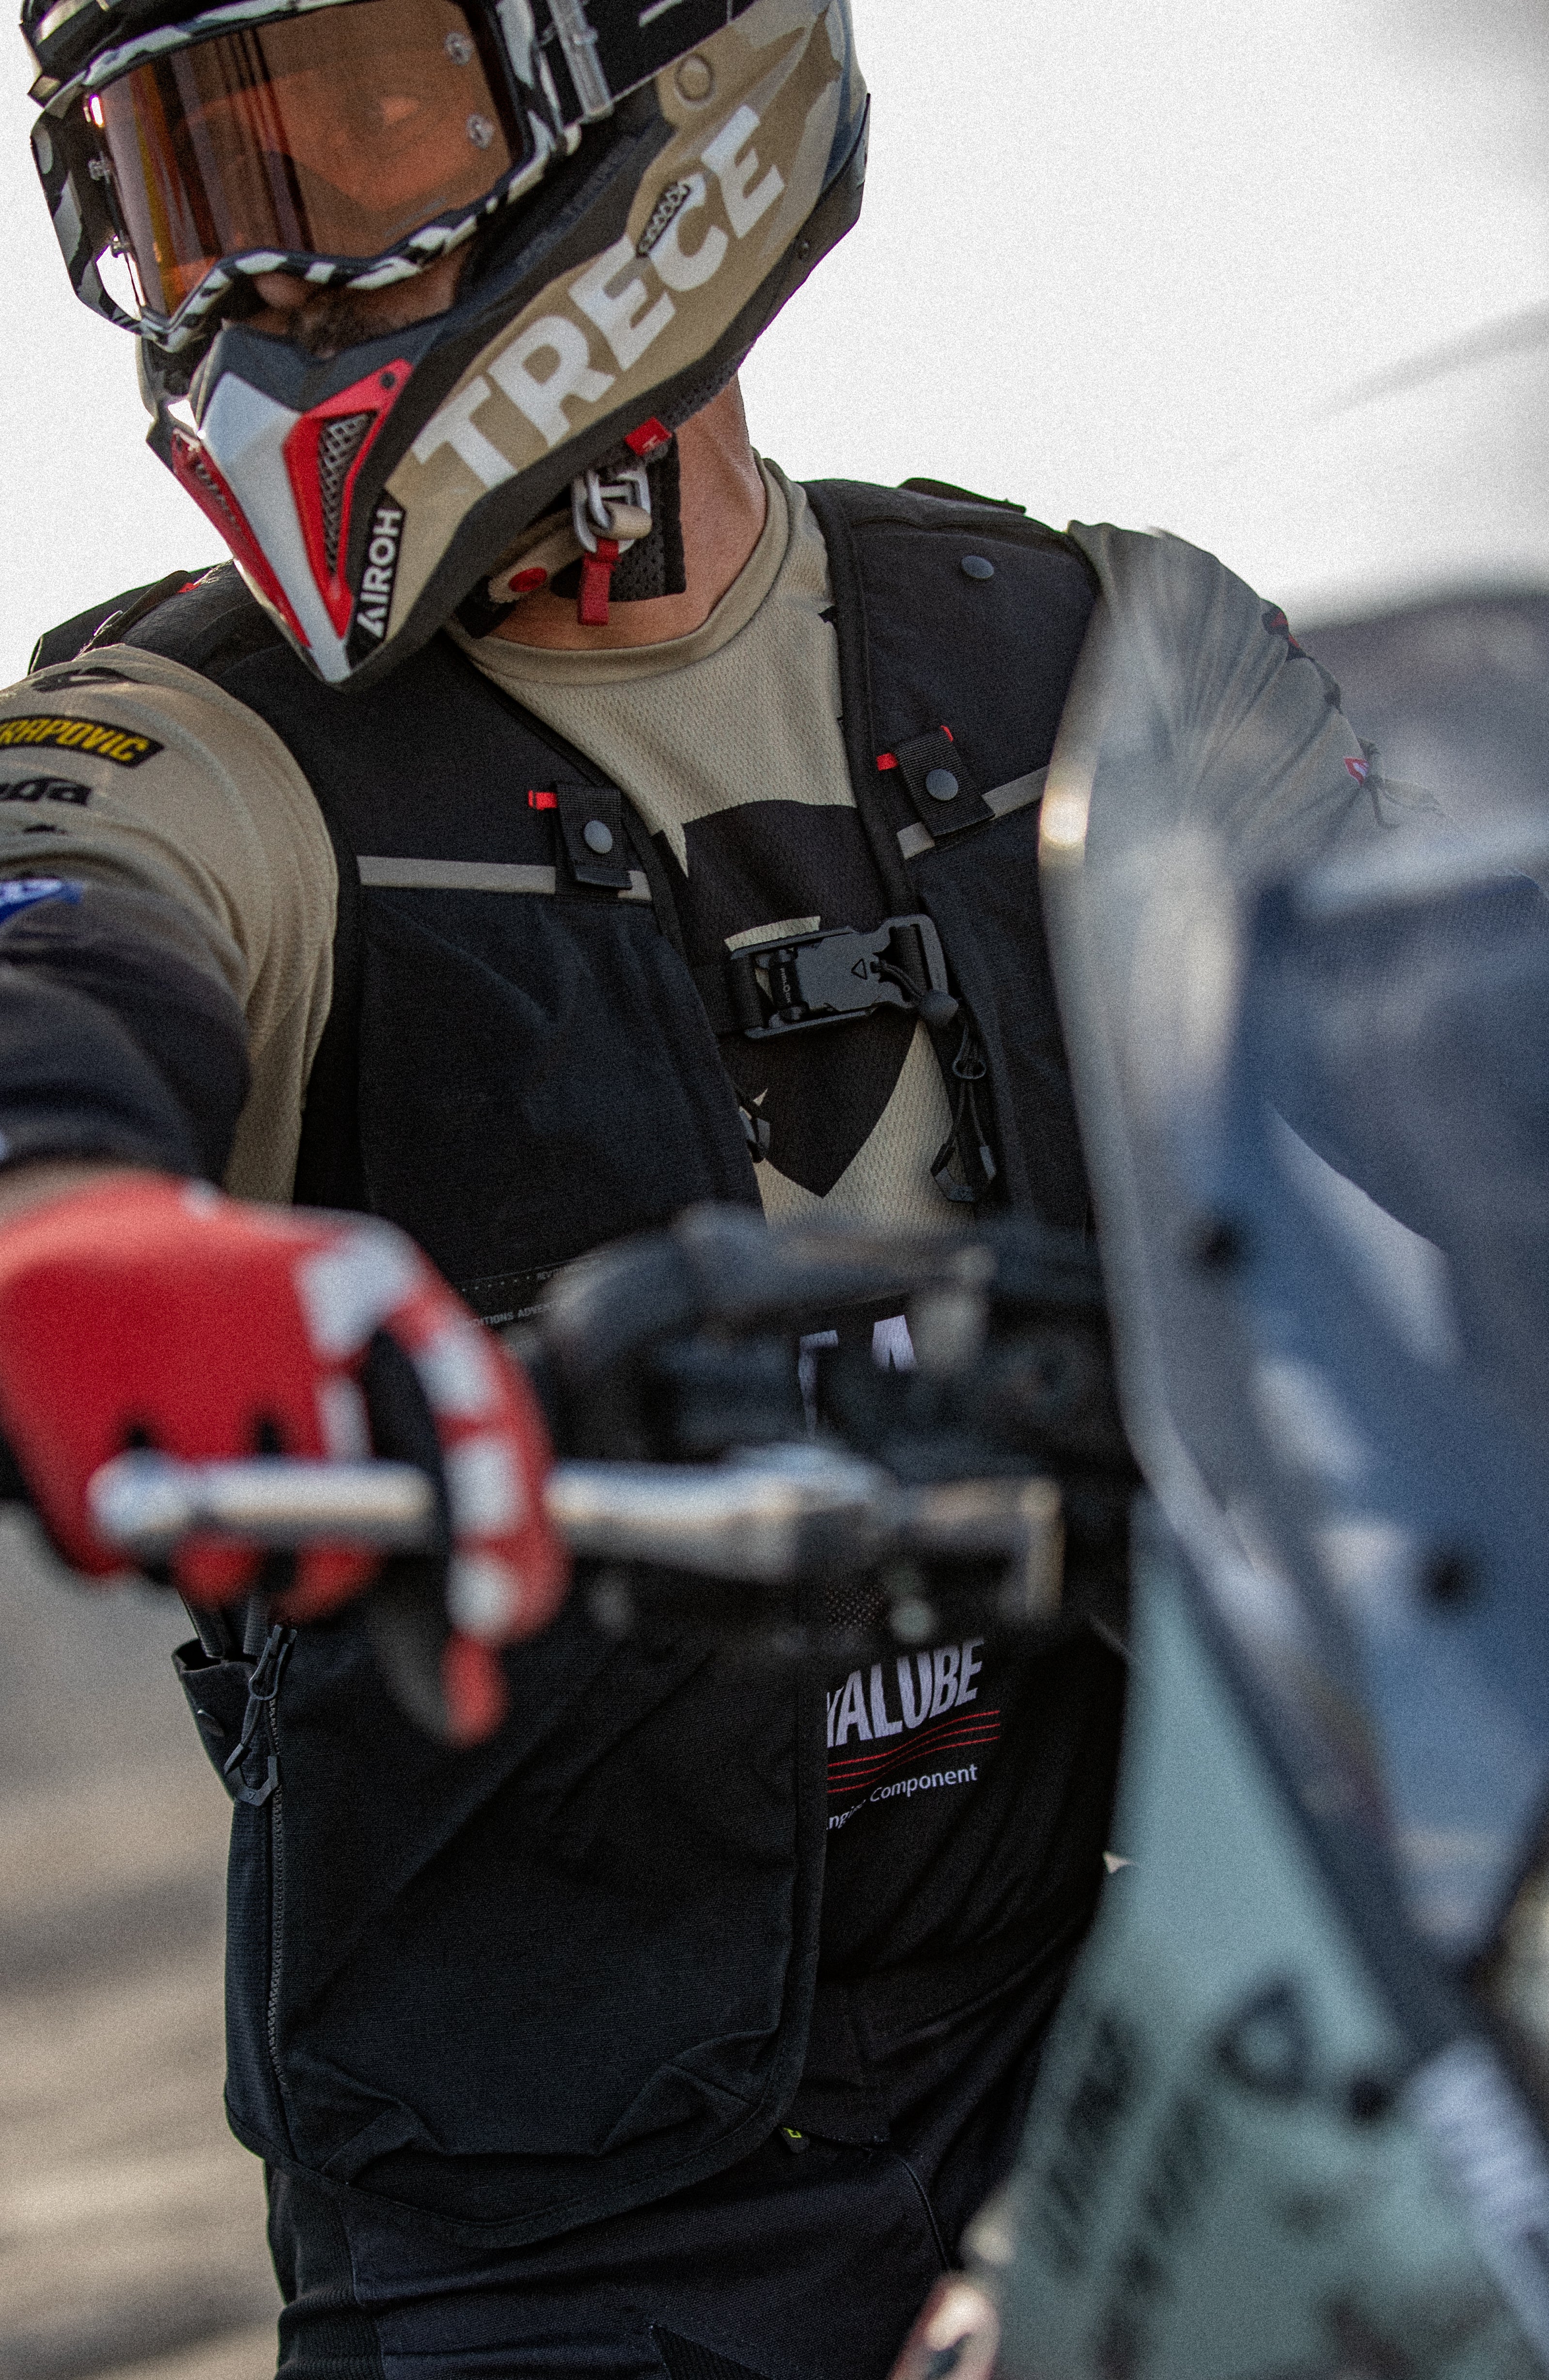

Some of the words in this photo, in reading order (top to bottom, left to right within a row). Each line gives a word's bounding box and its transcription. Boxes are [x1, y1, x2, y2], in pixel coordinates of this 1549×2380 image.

[409, 104, 786, 493] TRECE
[357, 509, 403, 638] AIROH
[870, 1764, 977, 1801] Component
